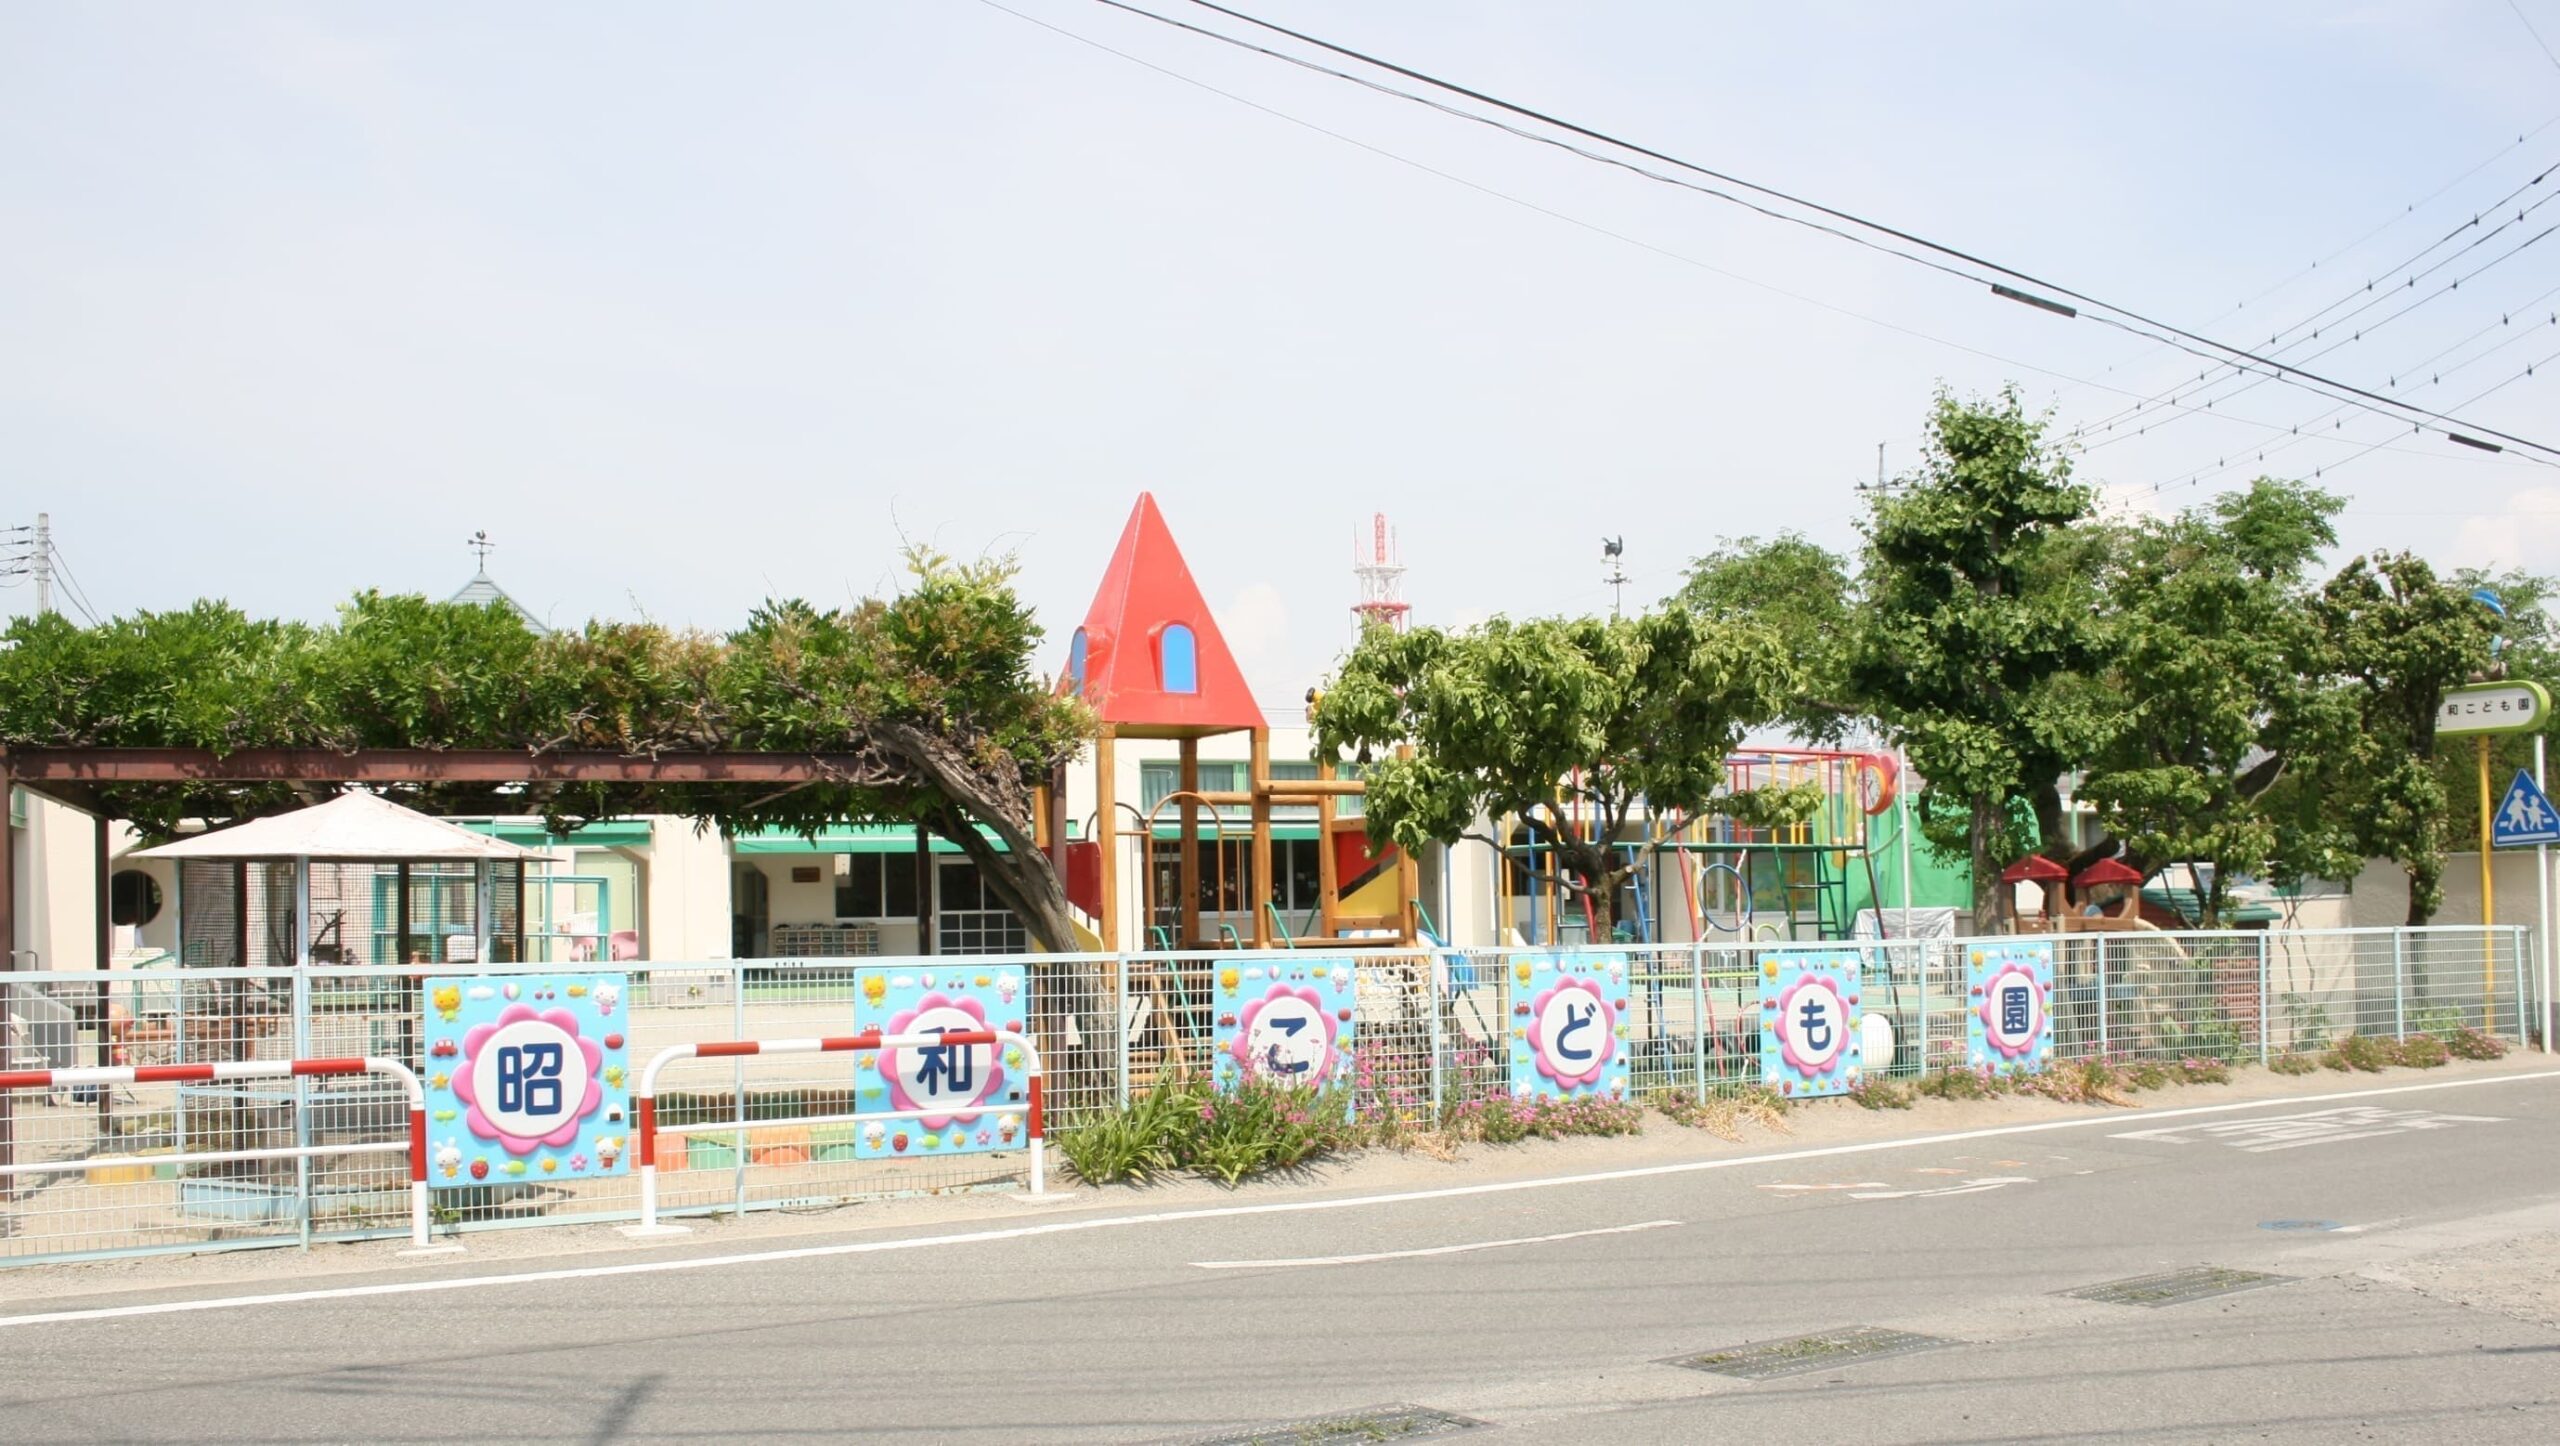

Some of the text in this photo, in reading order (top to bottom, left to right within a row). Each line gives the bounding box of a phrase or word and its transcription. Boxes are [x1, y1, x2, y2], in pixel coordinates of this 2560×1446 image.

[1556, 1002, 1596, 1060] ど
[1800, 998, 1831, 1051] も
[2002, 986, 2029, 1035] 園
[916, 1026, 972, 1096] 和
[1268, 1017, 1309, 1073] こ
[498, 1043, 563, 1116] 昭
